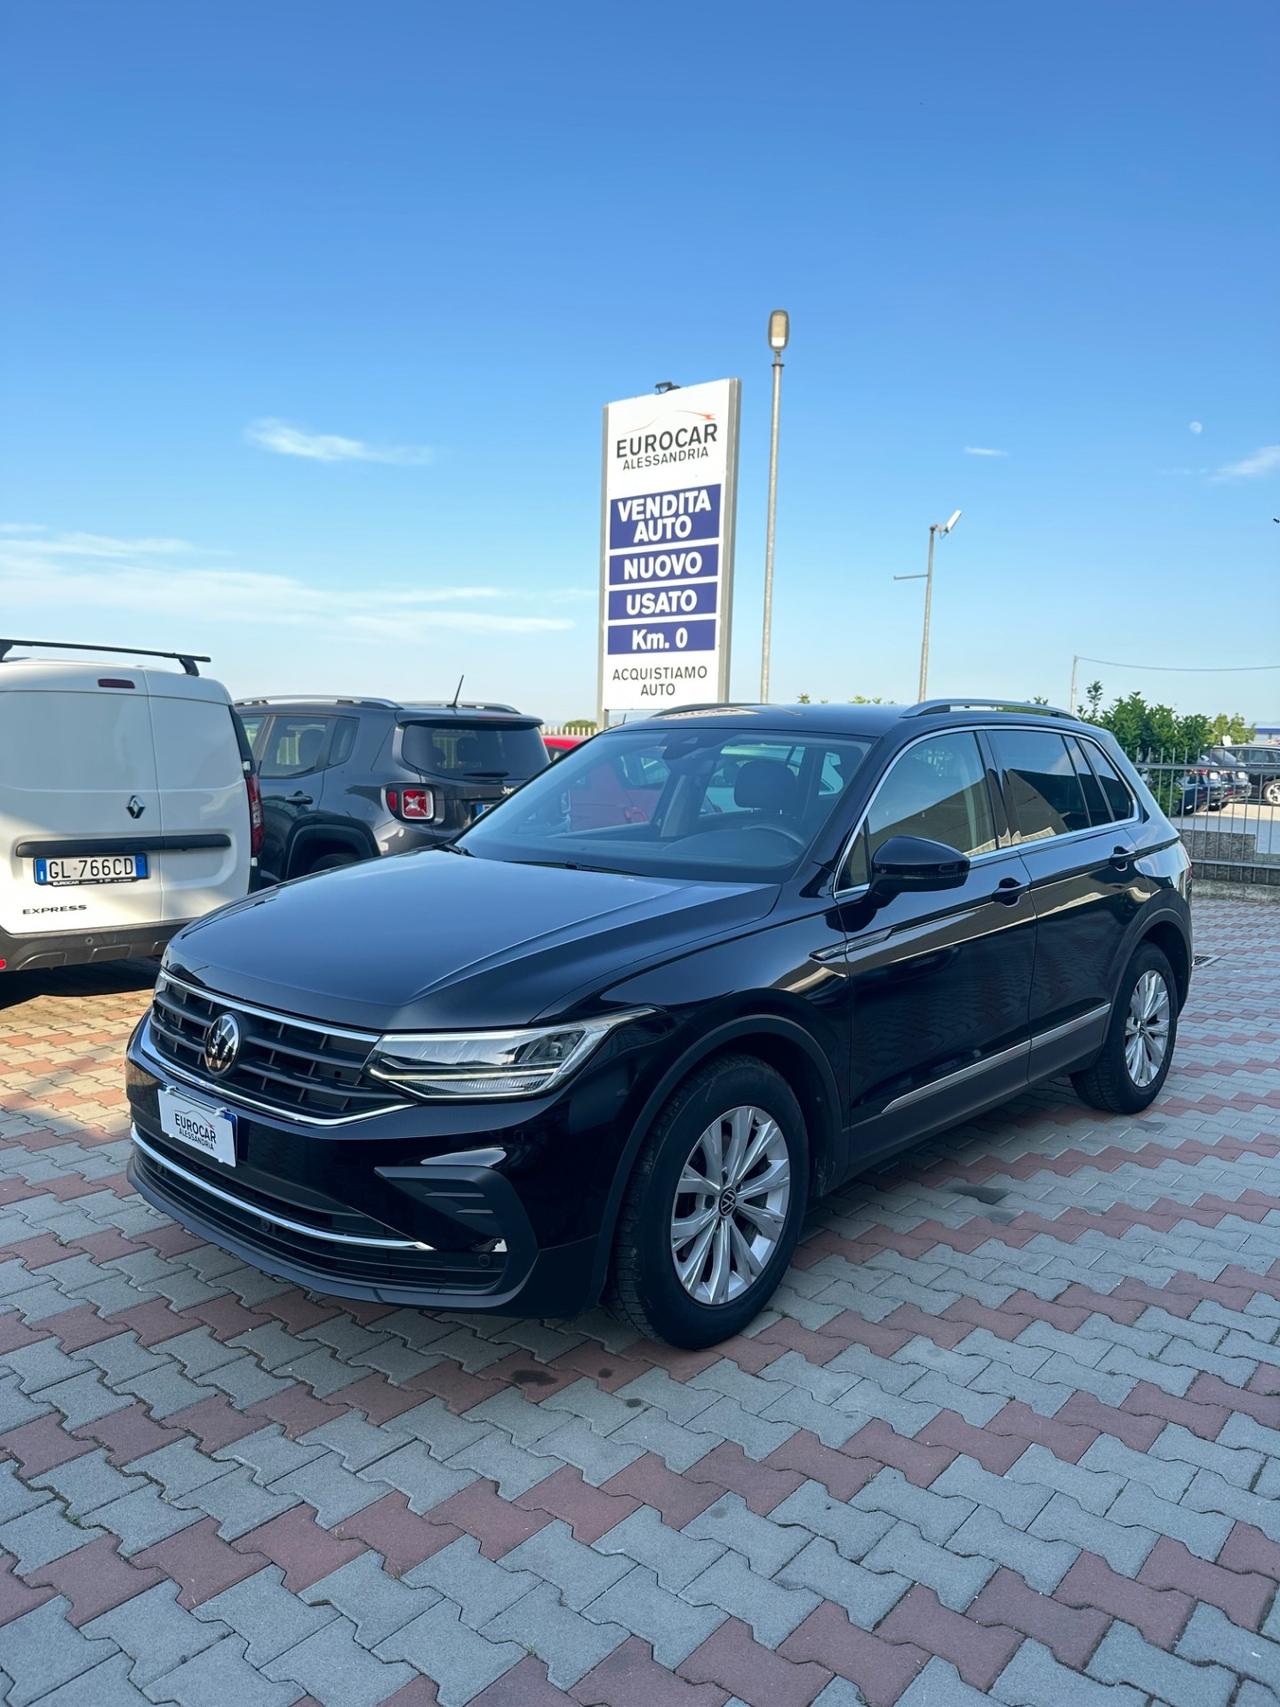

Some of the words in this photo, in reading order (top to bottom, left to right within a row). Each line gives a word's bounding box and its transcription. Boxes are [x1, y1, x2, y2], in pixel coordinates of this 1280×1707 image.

[616, 423, 718, 459] EUROCAR
[622, 446, 709, 471] ALESSANDRIA
[617, 489, 712, 522] VENDITA
[633, 515, 692, 544] AUTO
[623, 551, 703, 580] NUOVO
[626, 589, 698, 615] USATO
[631, 629, 670, 650] Km.
[675, 627, 688, 648] 0
[612, 665, 708, 681] ACQUISTIAMO
[640, 683, 676, 696] AUTO
[22, 904, 88, 914] EXPRESS
[174, 1112, 217, 1144] EUROCAR
[178, 1128, 215, 1151] ALESSANDRIA
